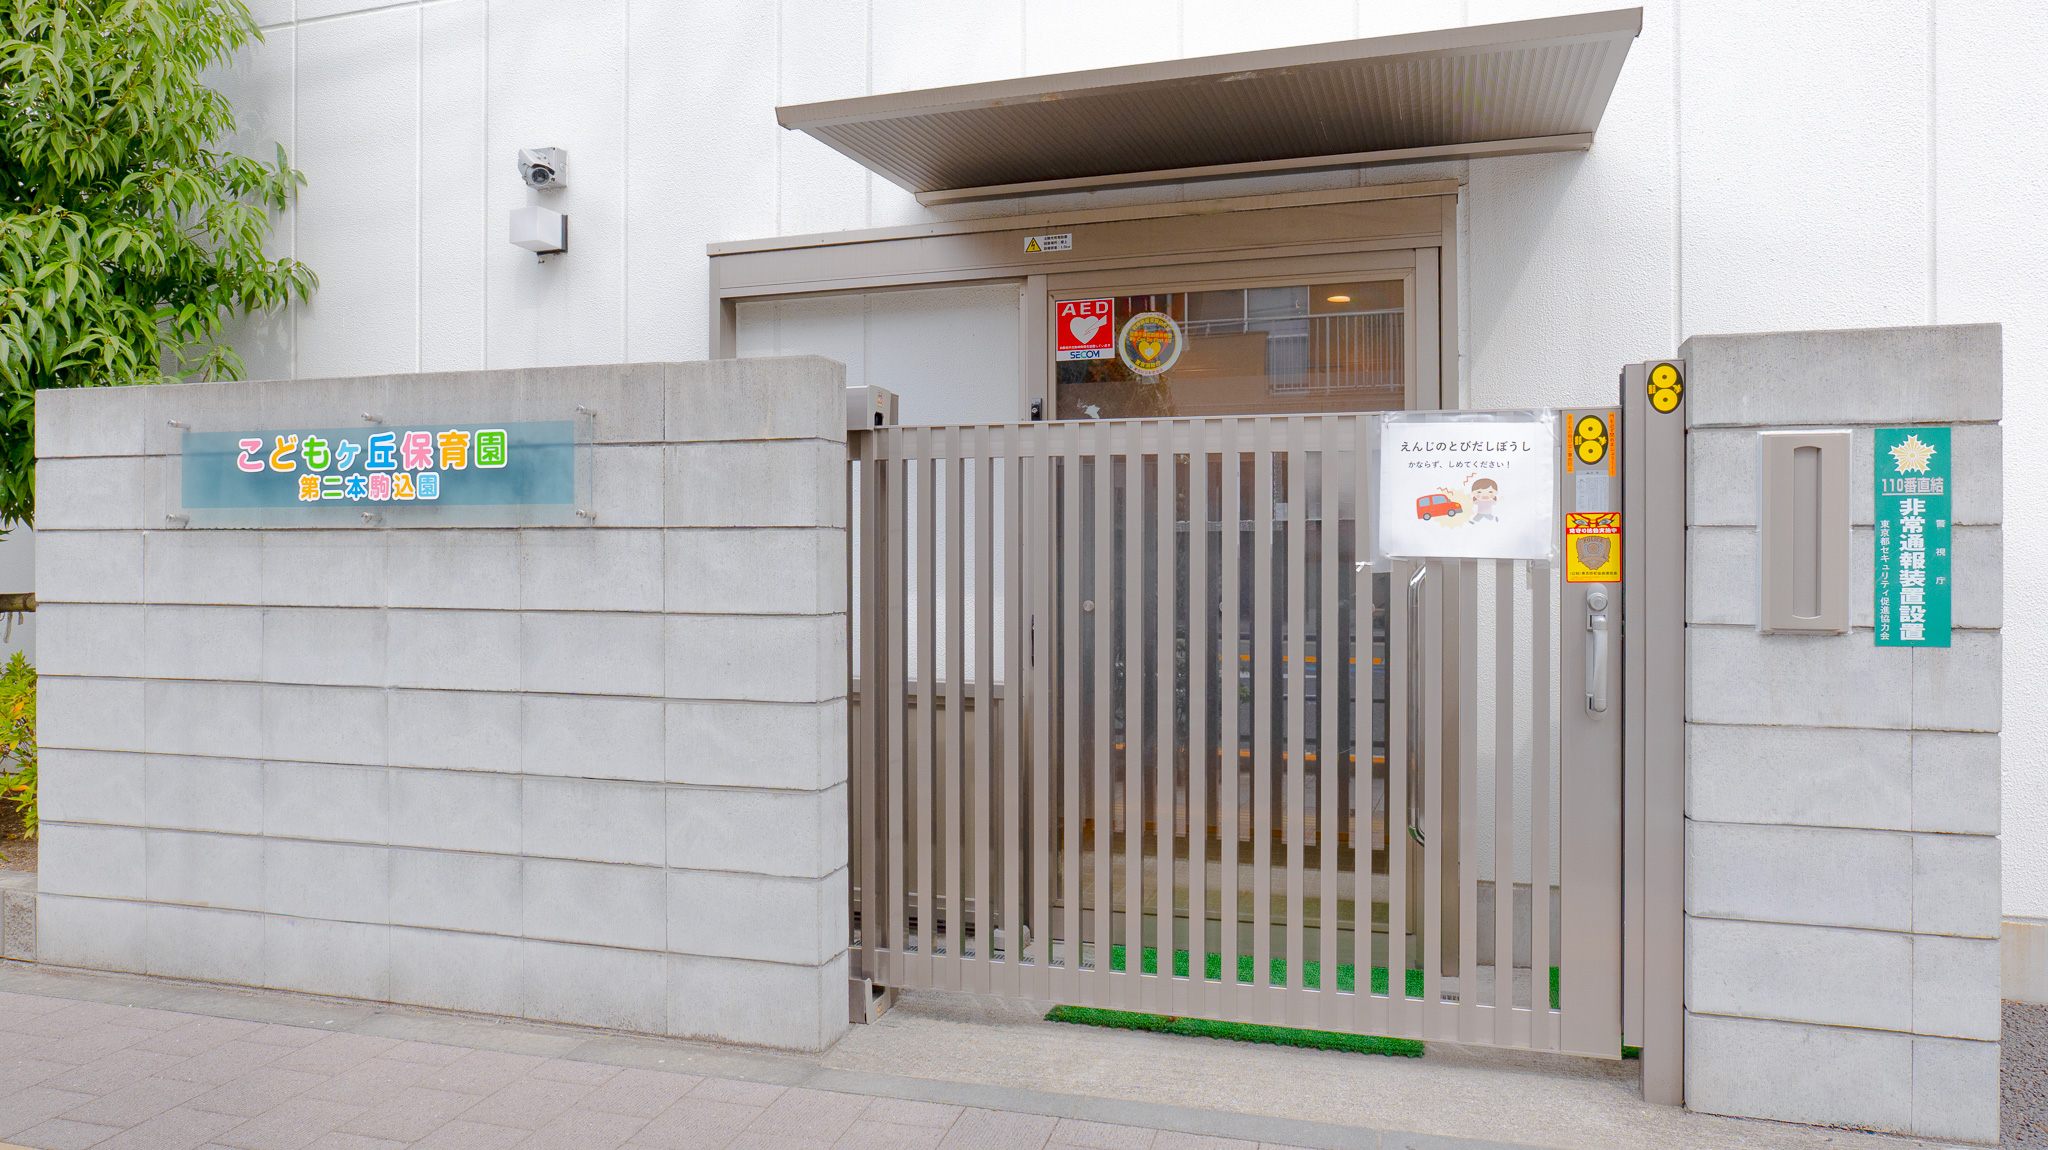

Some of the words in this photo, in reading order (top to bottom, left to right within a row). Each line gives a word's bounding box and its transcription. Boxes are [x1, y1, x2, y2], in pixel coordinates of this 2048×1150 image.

[1061, 301, 1109, 316] AED
[1070, 350, 1100, 359] SECOM
[1400, 441, 1531, 452] えんじのとびだしぼうし
[298, 472, 440, 502] 第二本駒込園
[1881, 477, 1944, 493] 110番直結
[1899, 498, 1926, 641] 非常通報装置設置
[1880, 520, 1890, 641] 東京都セキュリティ促進協力会
